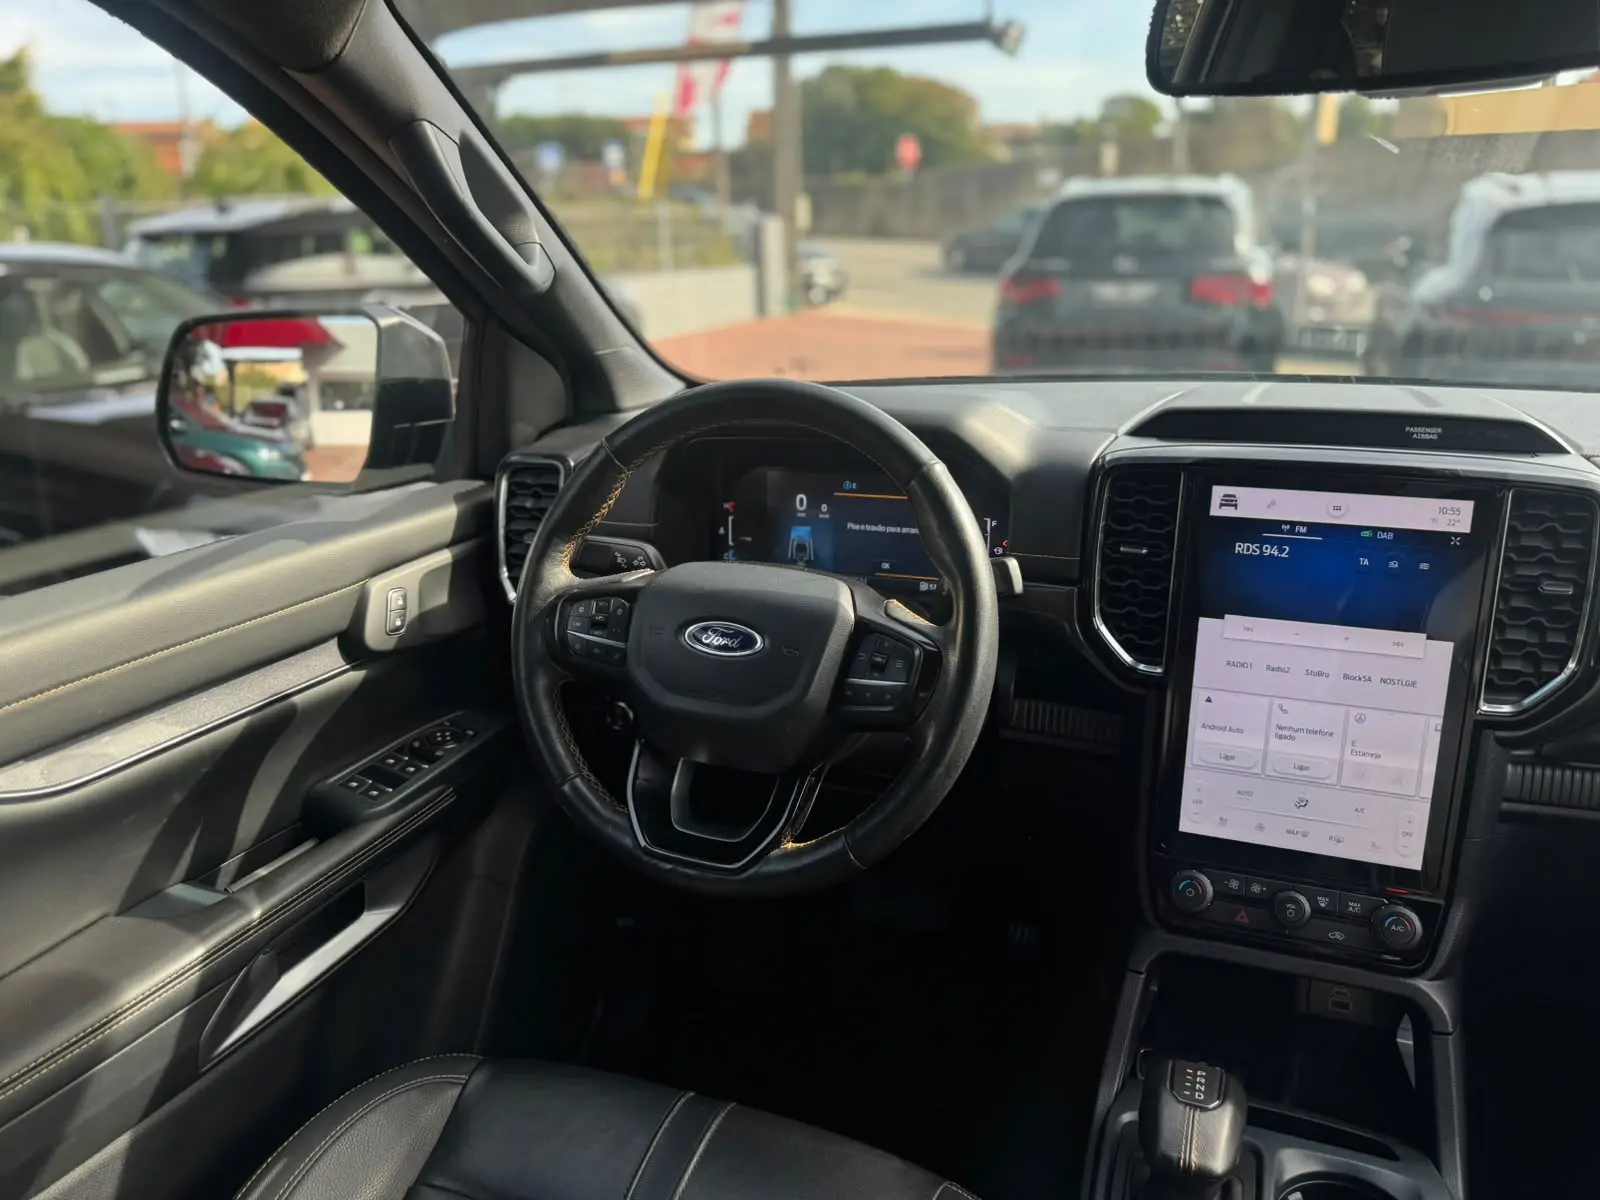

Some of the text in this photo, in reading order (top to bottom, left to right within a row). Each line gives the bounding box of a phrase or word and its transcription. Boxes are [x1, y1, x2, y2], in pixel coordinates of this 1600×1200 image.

[1405, 426, 1442, 434] PASSENGER
[796, 493, 807, 511] 0
[821, 503, 828, 512] 0
[1438, 506, 1461, 516] 10:55
[1295, 525, 1307, 534] FM
[1377, 531, 1394, 540] DAB
[1234, 542, 1290, 558] RDS 94.2
[881, 562, 890, 570] OK
[1359, 557, 1369, 566] TA
[702, 627, 744, 649] Ford
[1226, 659, 1249, 669] RADIO
[1265, 664, 1291, 674] Radio2
[1305, 668, 1330, 679] StuBru
[1380, 677, 1418, 689] NOSTLGIE
[1201, 722, 1244, 735] Android Auto
[1275, 723, 1335, 738] Nenhum telefone
[1274, 732, 1296, 742] ligado
[1236, 789, 1254, 798] AUTO
[1348, 906, 1361, 914] A/C
[1390, 923, 1405, 933] A/C
